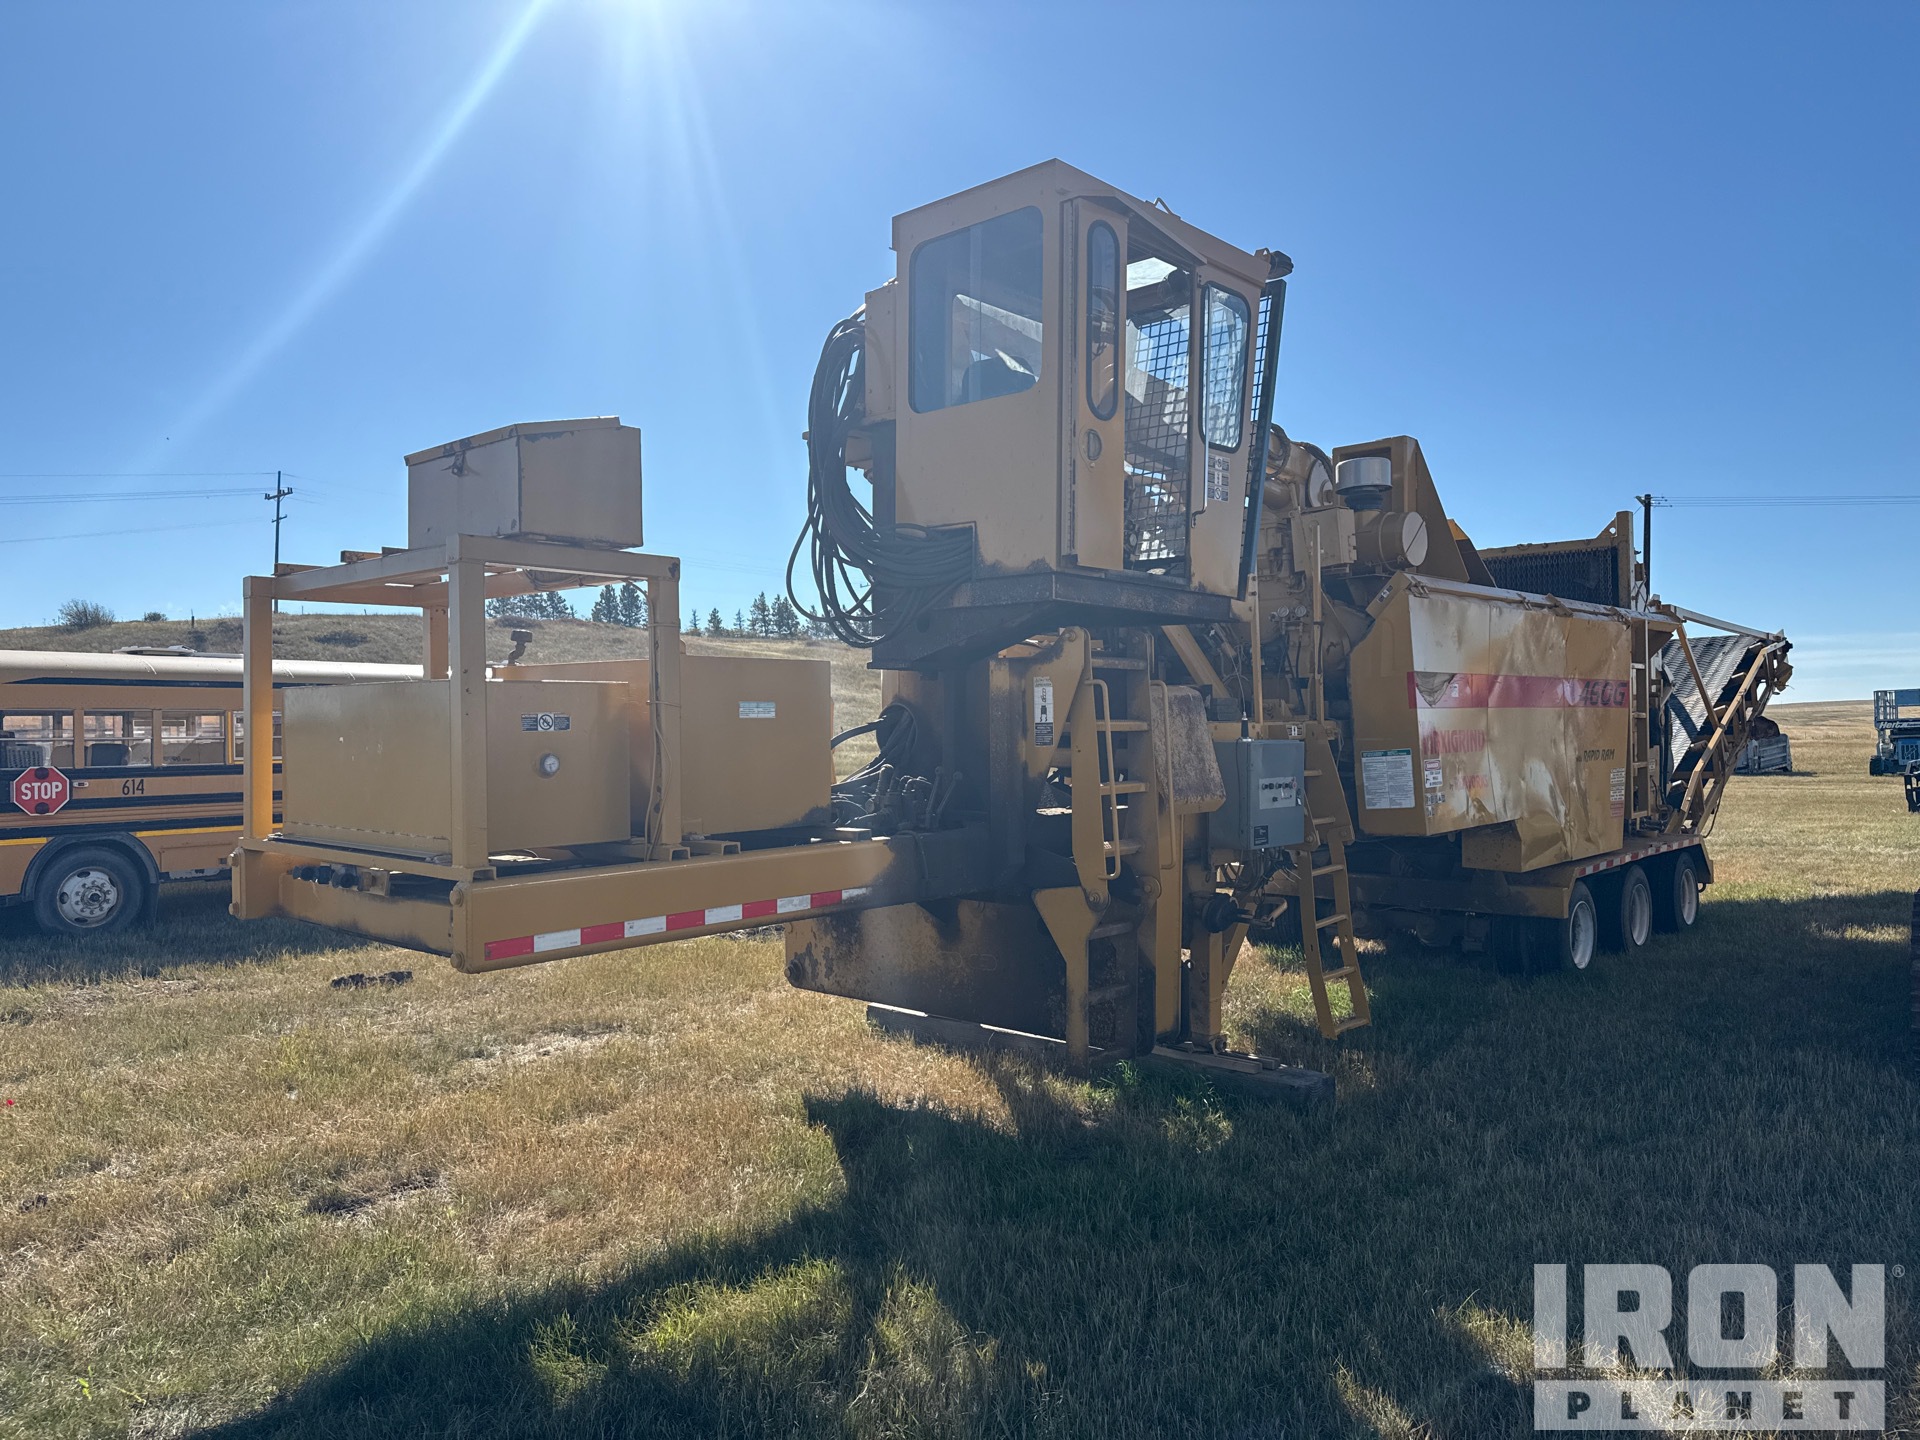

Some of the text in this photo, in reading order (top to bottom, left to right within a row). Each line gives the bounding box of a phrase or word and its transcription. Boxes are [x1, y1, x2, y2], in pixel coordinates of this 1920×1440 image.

[1579, 681, 1627, 706] 460G
[1584, 749, 1601, 762] RAPID
[1601, 748, 1616, 761] RAM
[21, 781, 62, 800] STOP
[122, 779, 145, 795] 614
